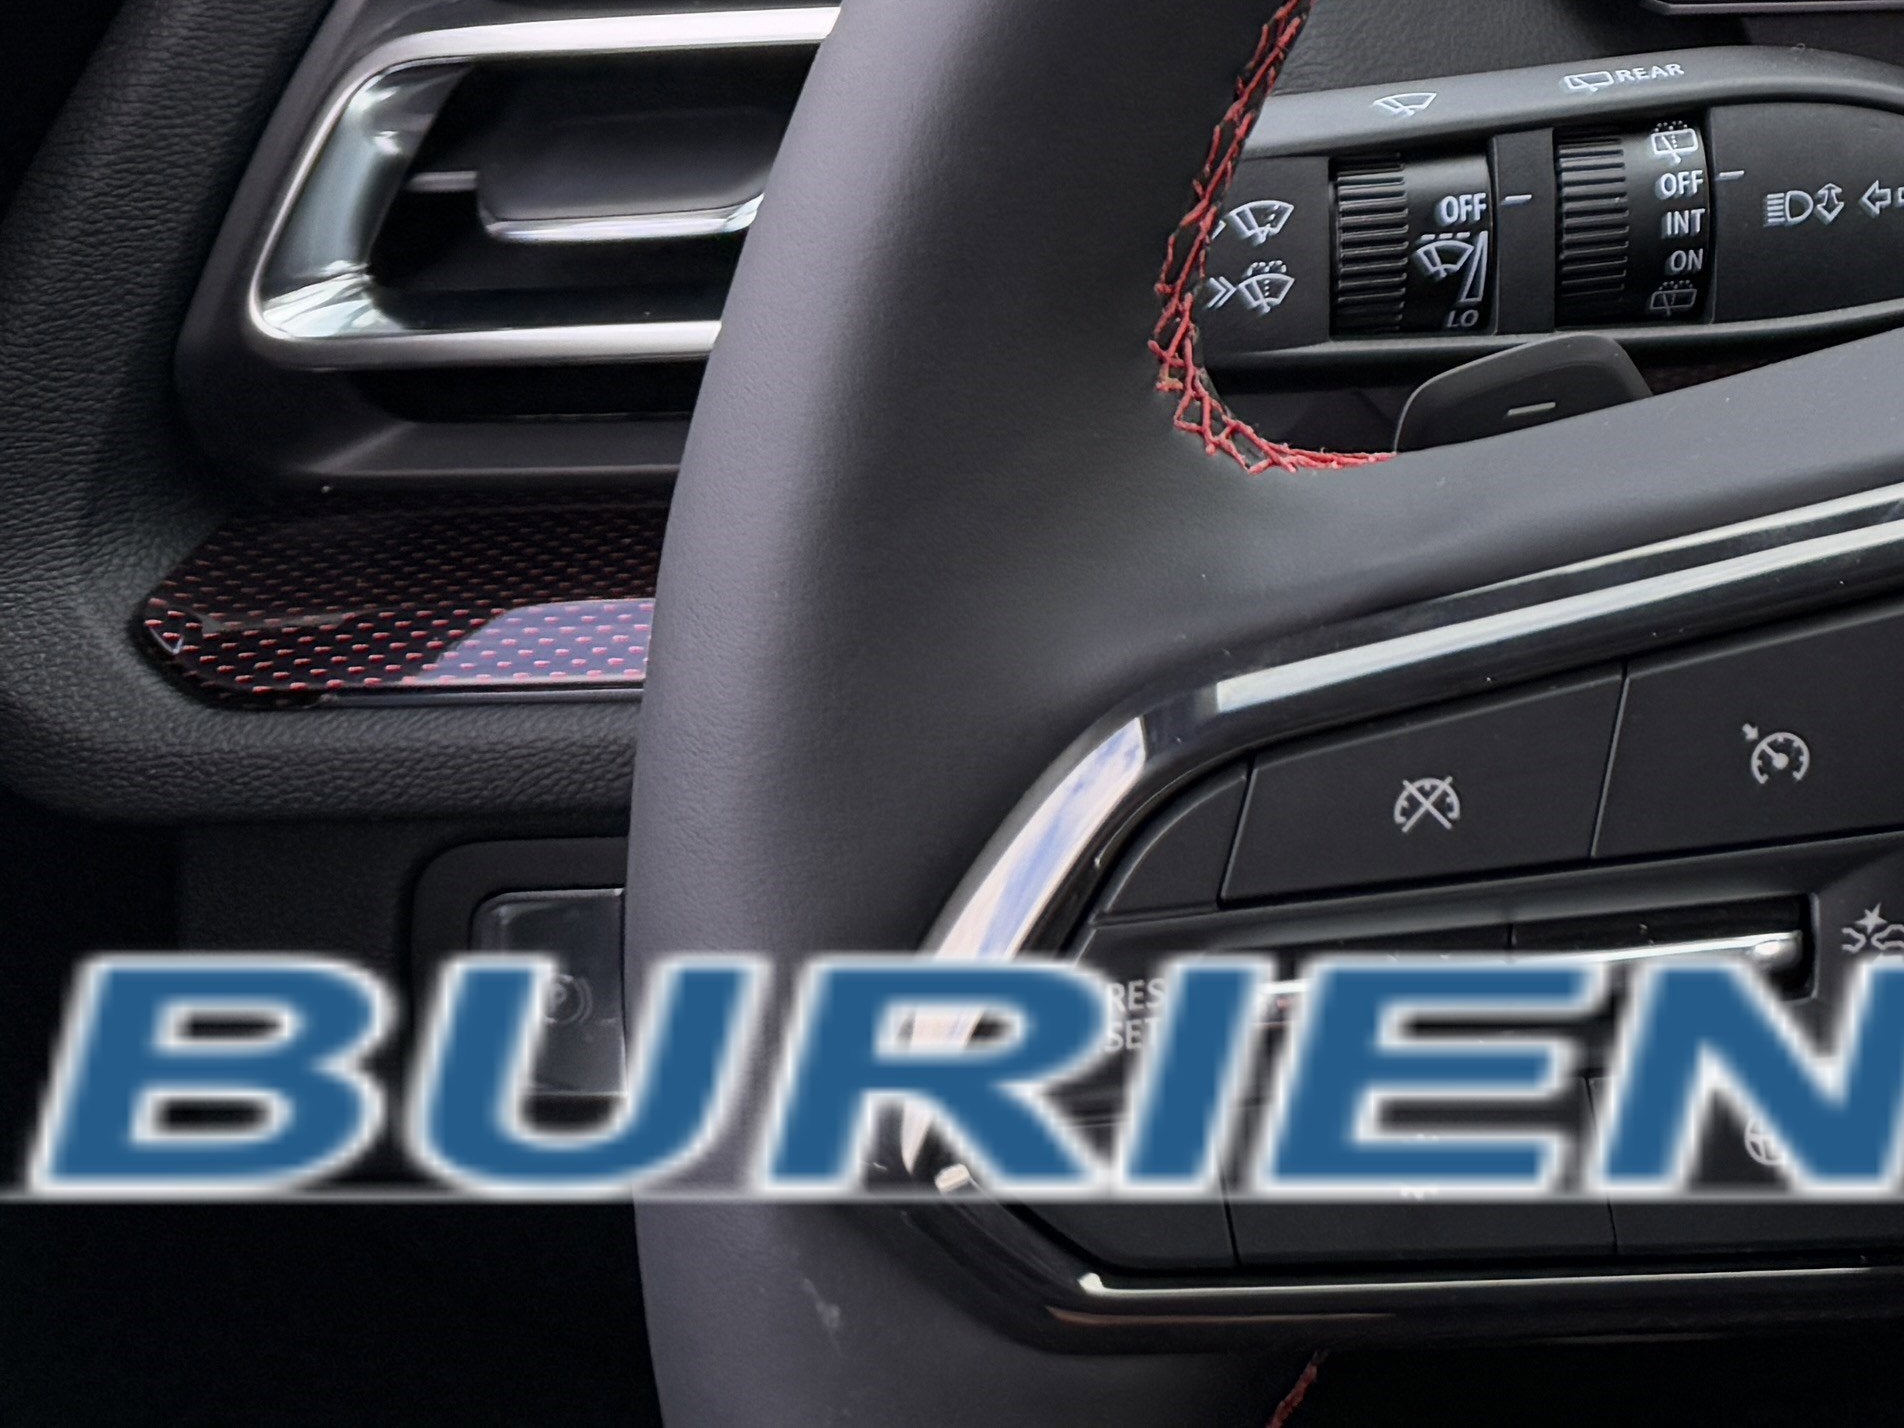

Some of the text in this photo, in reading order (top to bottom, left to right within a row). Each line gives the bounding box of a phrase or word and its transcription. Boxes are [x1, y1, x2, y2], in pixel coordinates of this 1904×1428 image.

[1613, 63, 1685, 83] REAR
[1655, 170, 1704, 200] OFF
[1436, 192, 1488, 227] OFF
[1661, 208, 1706, 238] INT
[1667, 248, 1705, 274] ON
[1446, 309, 1480, 329] LO
